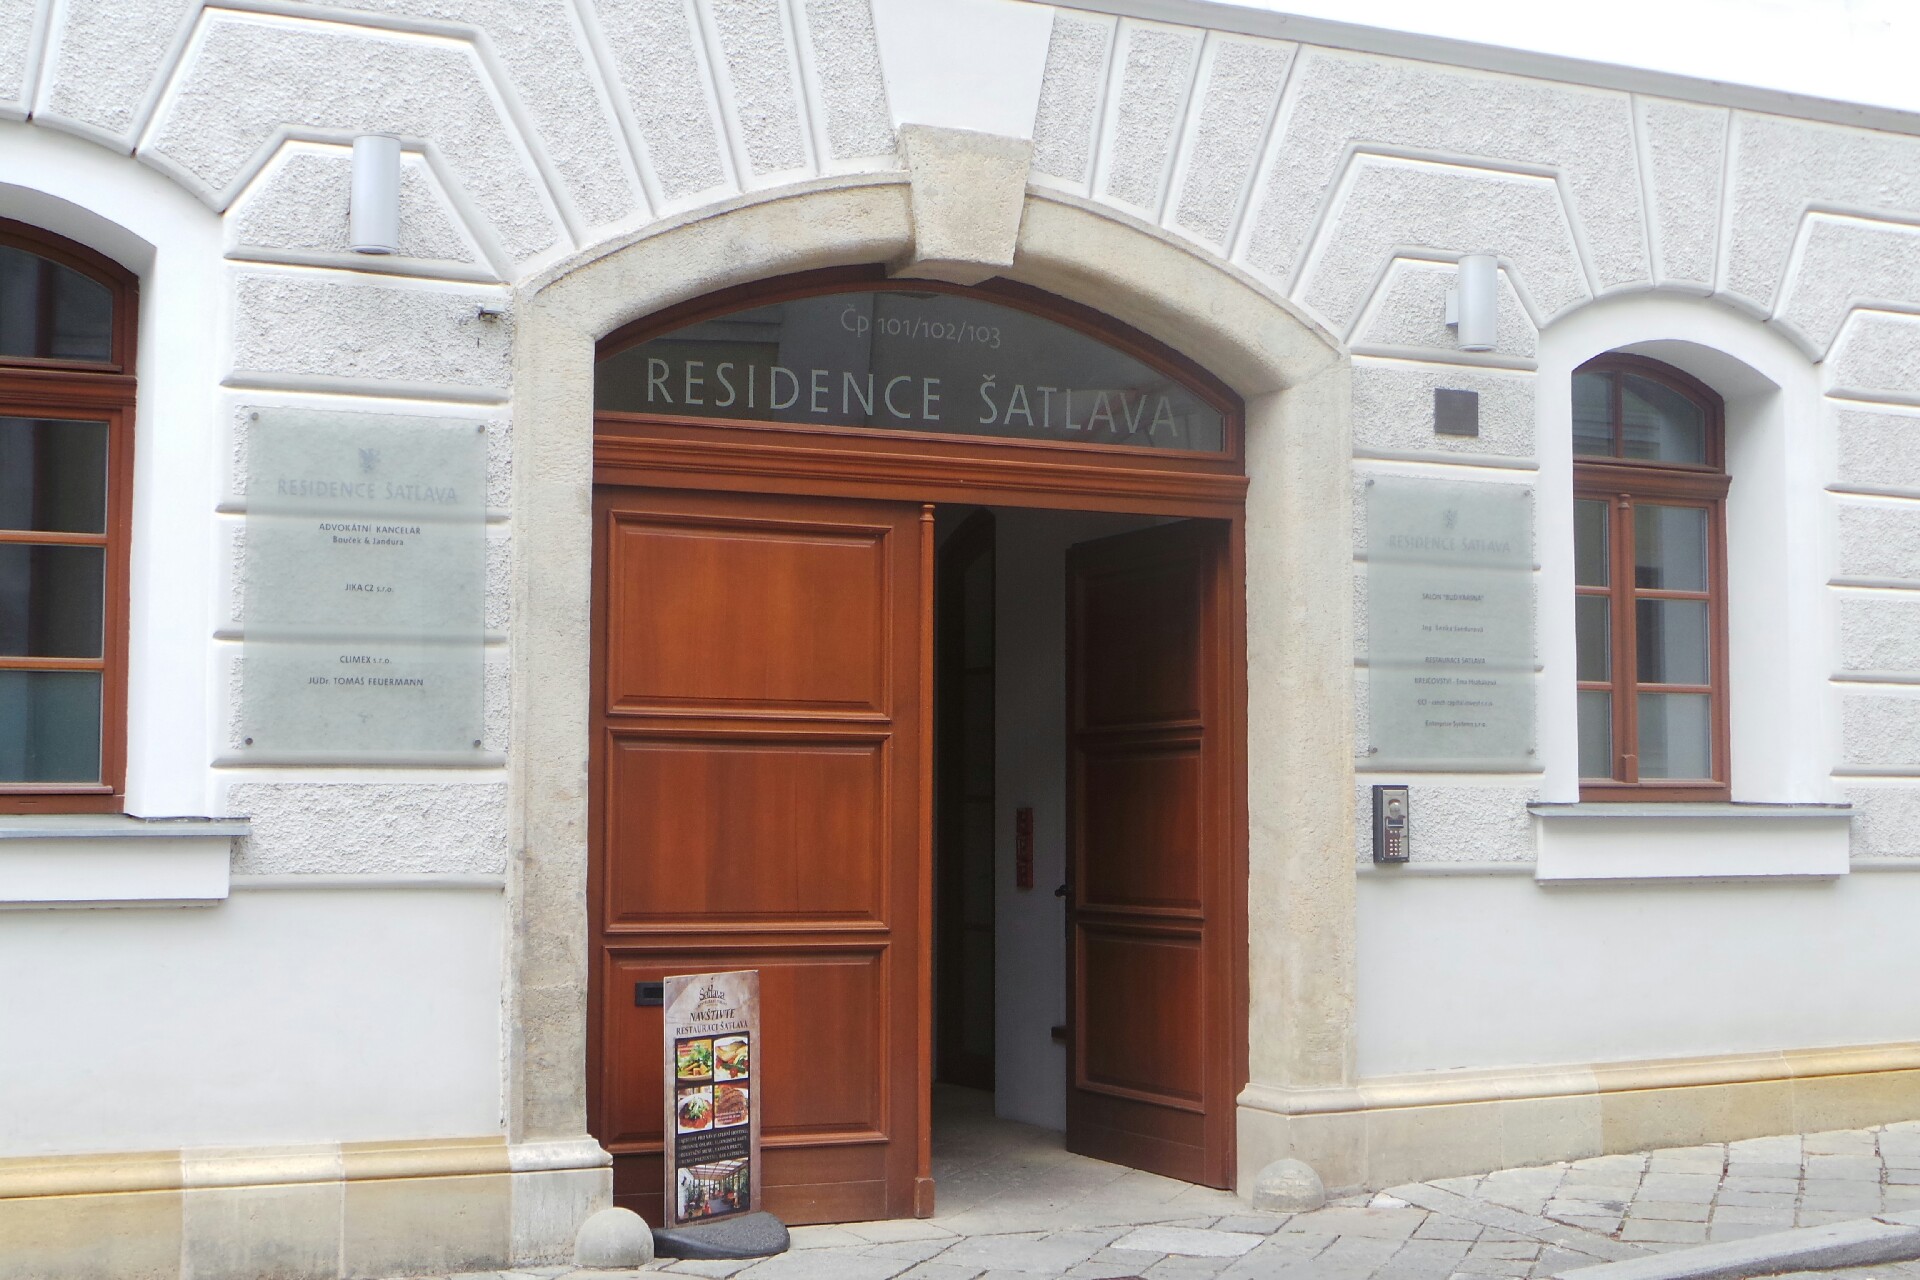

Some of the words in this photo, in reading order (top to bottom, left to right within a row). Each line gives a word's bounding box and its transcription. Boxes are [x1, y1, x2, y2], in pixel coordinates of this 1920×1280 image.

[840, 303, 869, 338] Čp
[877, 316, 1001, 349] 101/102/103
[646, 356, 941, 422] RESIDENCE
[980, 374, 1180, 438] ŠATLAVA
[277, 478, 375, 499] RESIDENCE
[385, 483, 458, 503] ŠATLAVA
[364, 536, 371, 545] &
[372, 537, 404, 546] Jandura
[1388, 534, 1456, 551] RESIDENCE
[344, 583, 363, 592] JIKA
[339, 655, 371, 664] CLIMEX
[368, 677, 424, 686] FEUERMANN
